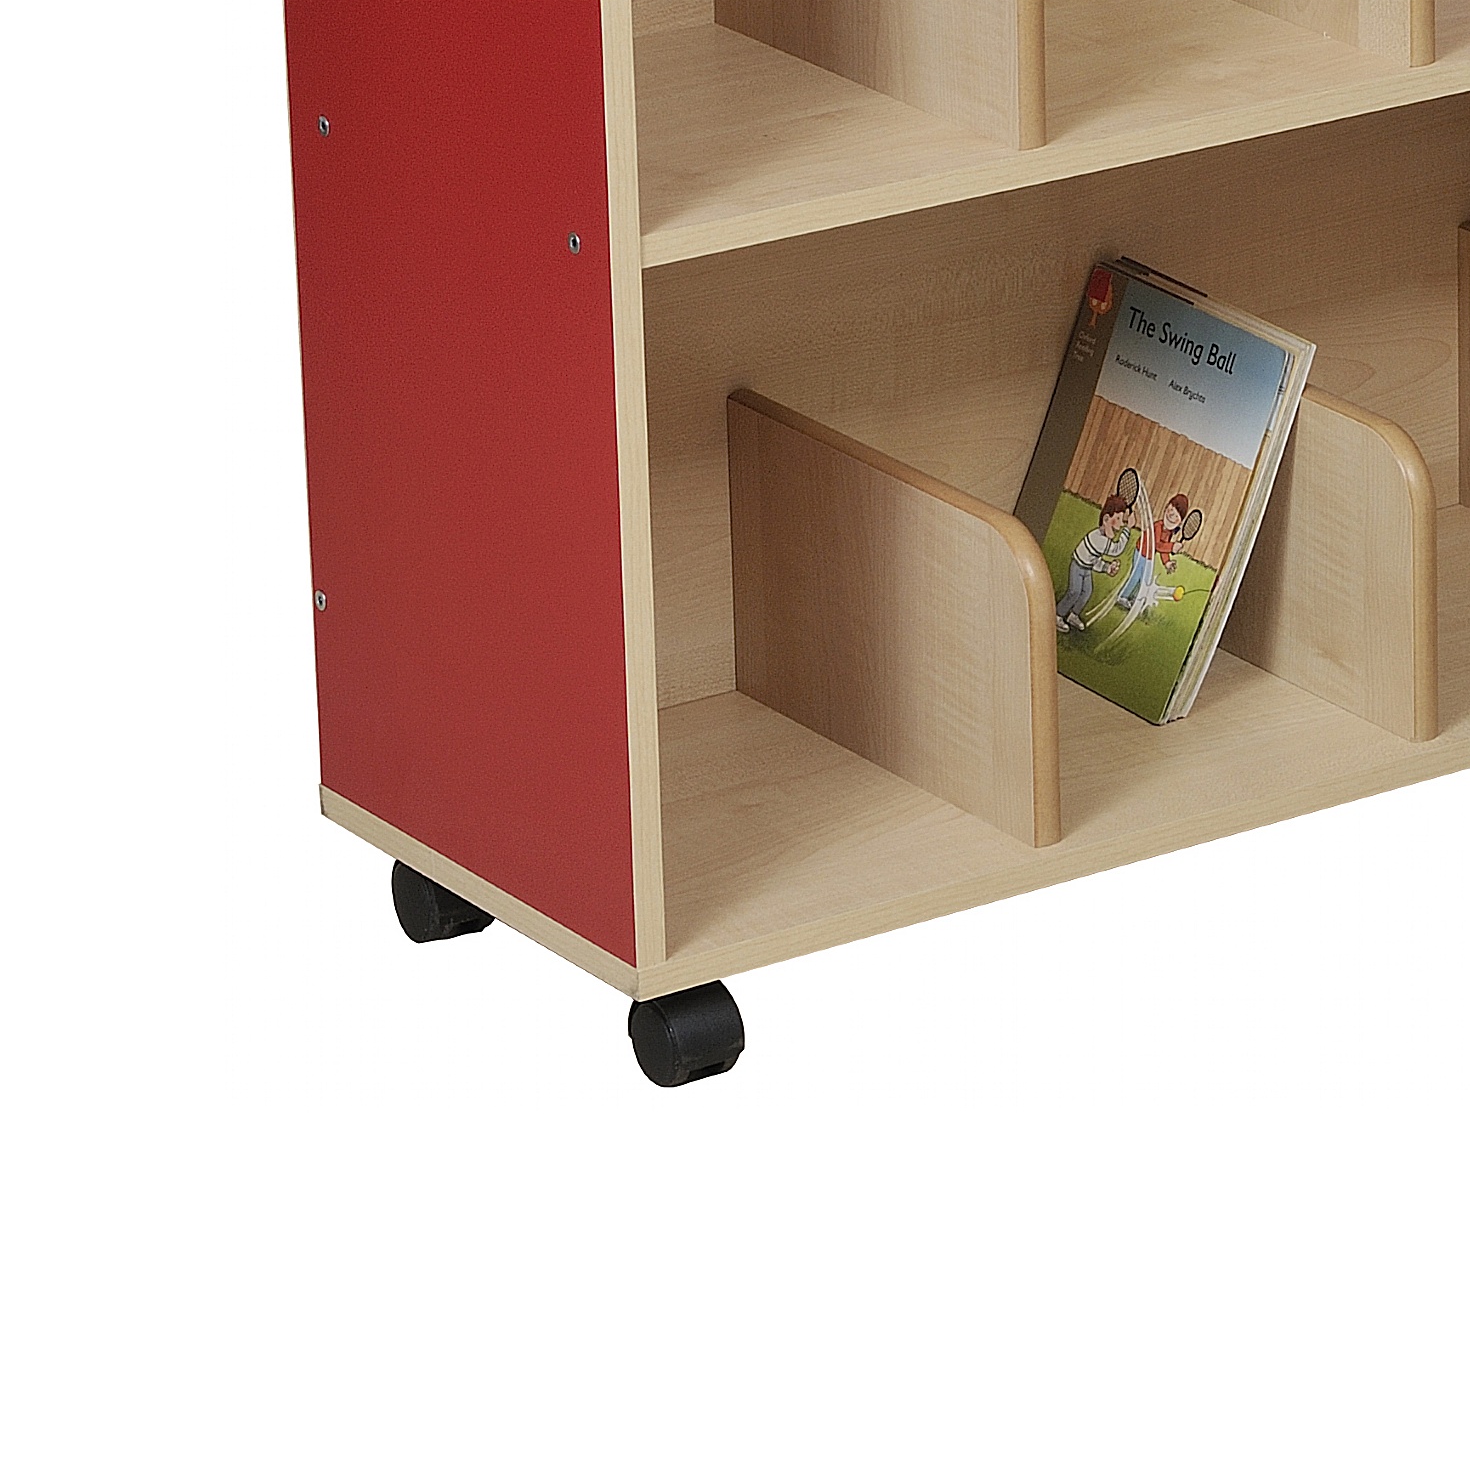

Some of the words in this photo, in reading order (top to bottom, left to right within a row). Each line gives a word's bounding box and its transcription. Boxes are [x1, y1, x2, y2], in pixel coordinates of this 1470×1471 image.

[1129, 306, 1156, 338] The
[1158, 322, 1204, 366] Swing
[1206, 343, 1237, 375] Ball
[1115, 354, 1142, 373] Roderick
[1142, 365, 1158, 381] Hunt
[1168, 379, 1182, 393] Alex
[1182, 385, 1206, 404] Brychta
